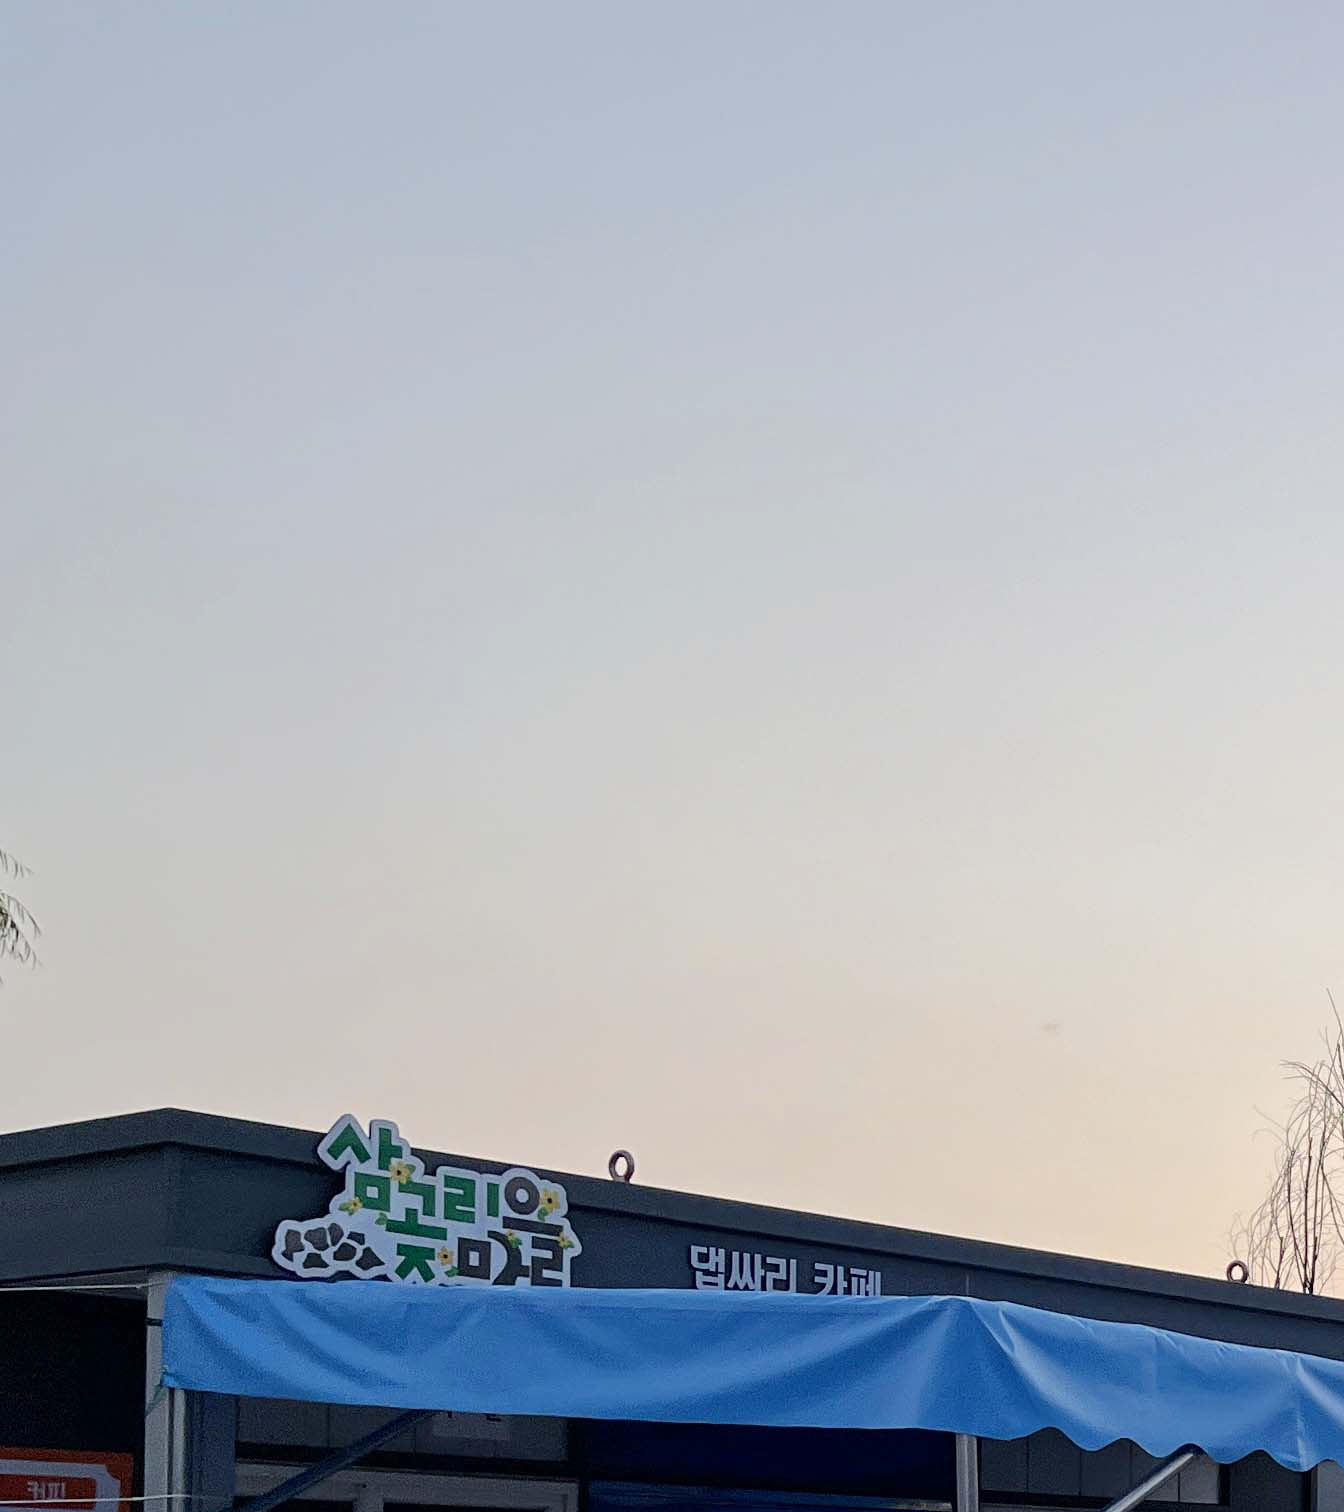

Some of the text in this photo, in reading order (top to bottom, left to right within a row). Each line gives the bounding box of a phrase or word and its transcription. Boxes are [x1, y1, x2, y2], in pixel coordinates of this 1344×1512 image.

[690, 1244, 882, 1297] 댑싸리 카페
[27, 1481, 66, 1500] 커피
